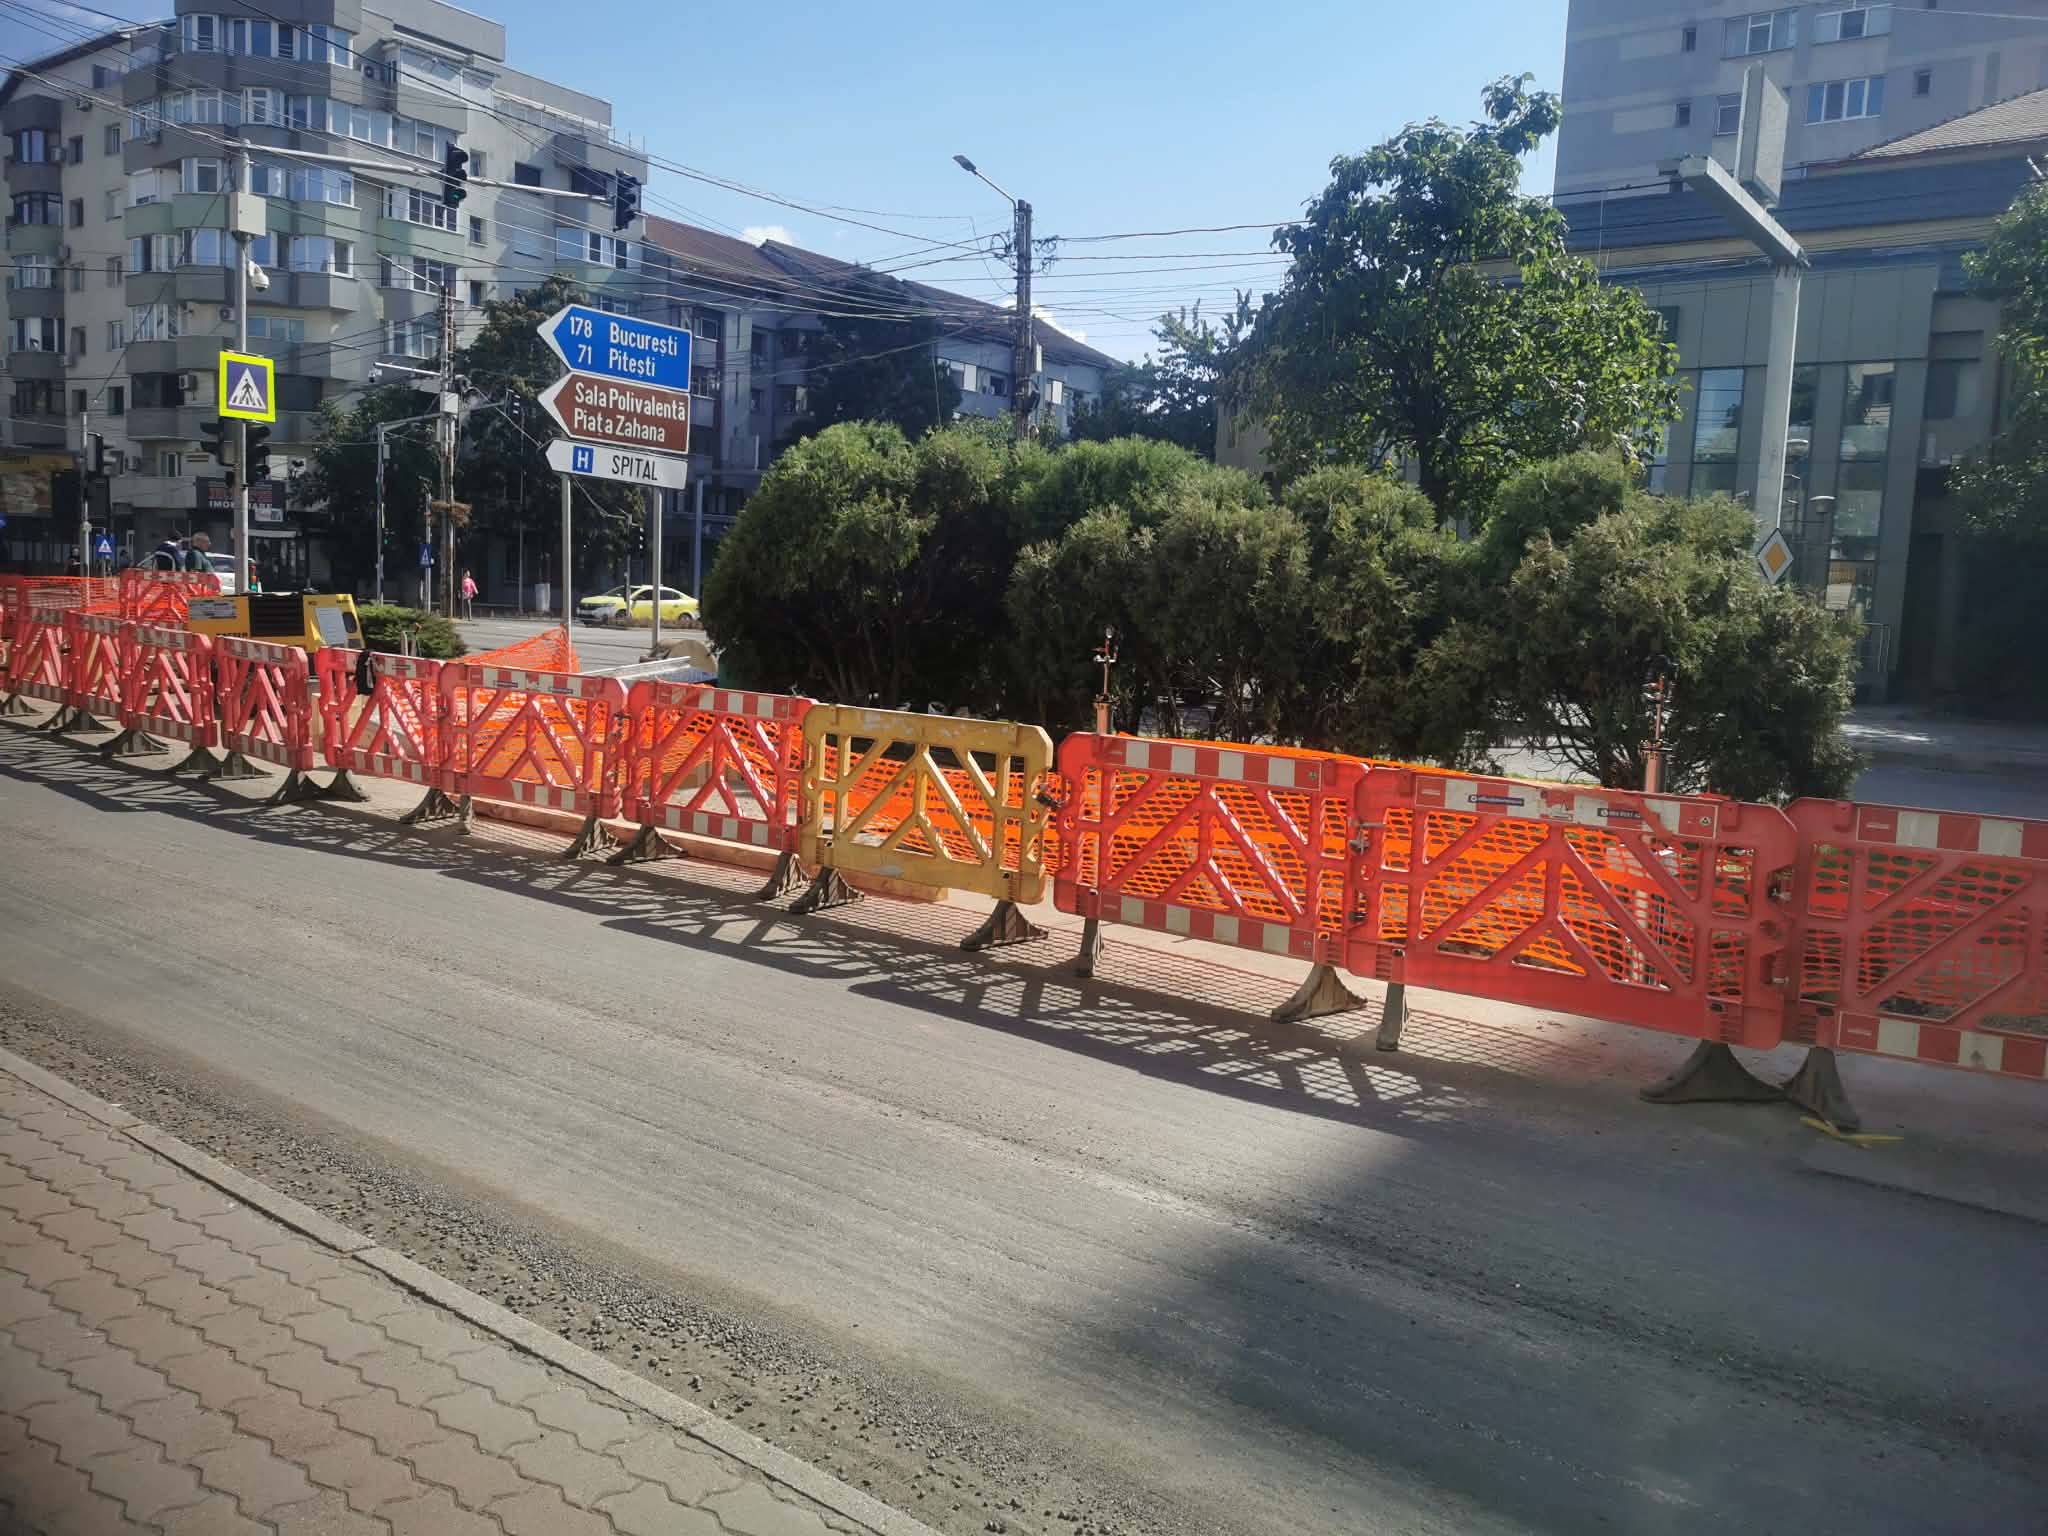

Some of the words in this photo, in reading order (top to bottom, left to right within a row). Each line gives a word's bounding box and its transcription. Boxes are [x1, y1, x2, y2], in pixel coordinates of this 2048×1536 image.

[570, 316, 593, 338] 178
[609, 322, 678, 357] București
[578, 344, 592, 365] 71
[609, 348, 656, 378] Pitești
[575, 382, 607, 409] Sala
[609, 388, 686, 421] Polivalentă
[574, 409, 613, 436] Piața
[616, 416, 665, 442] Zahana
[577, 451, 589, 469] H
[612, 455, 658, 481] SPITAL
[208, 500, 273, 513] IMOIARE
